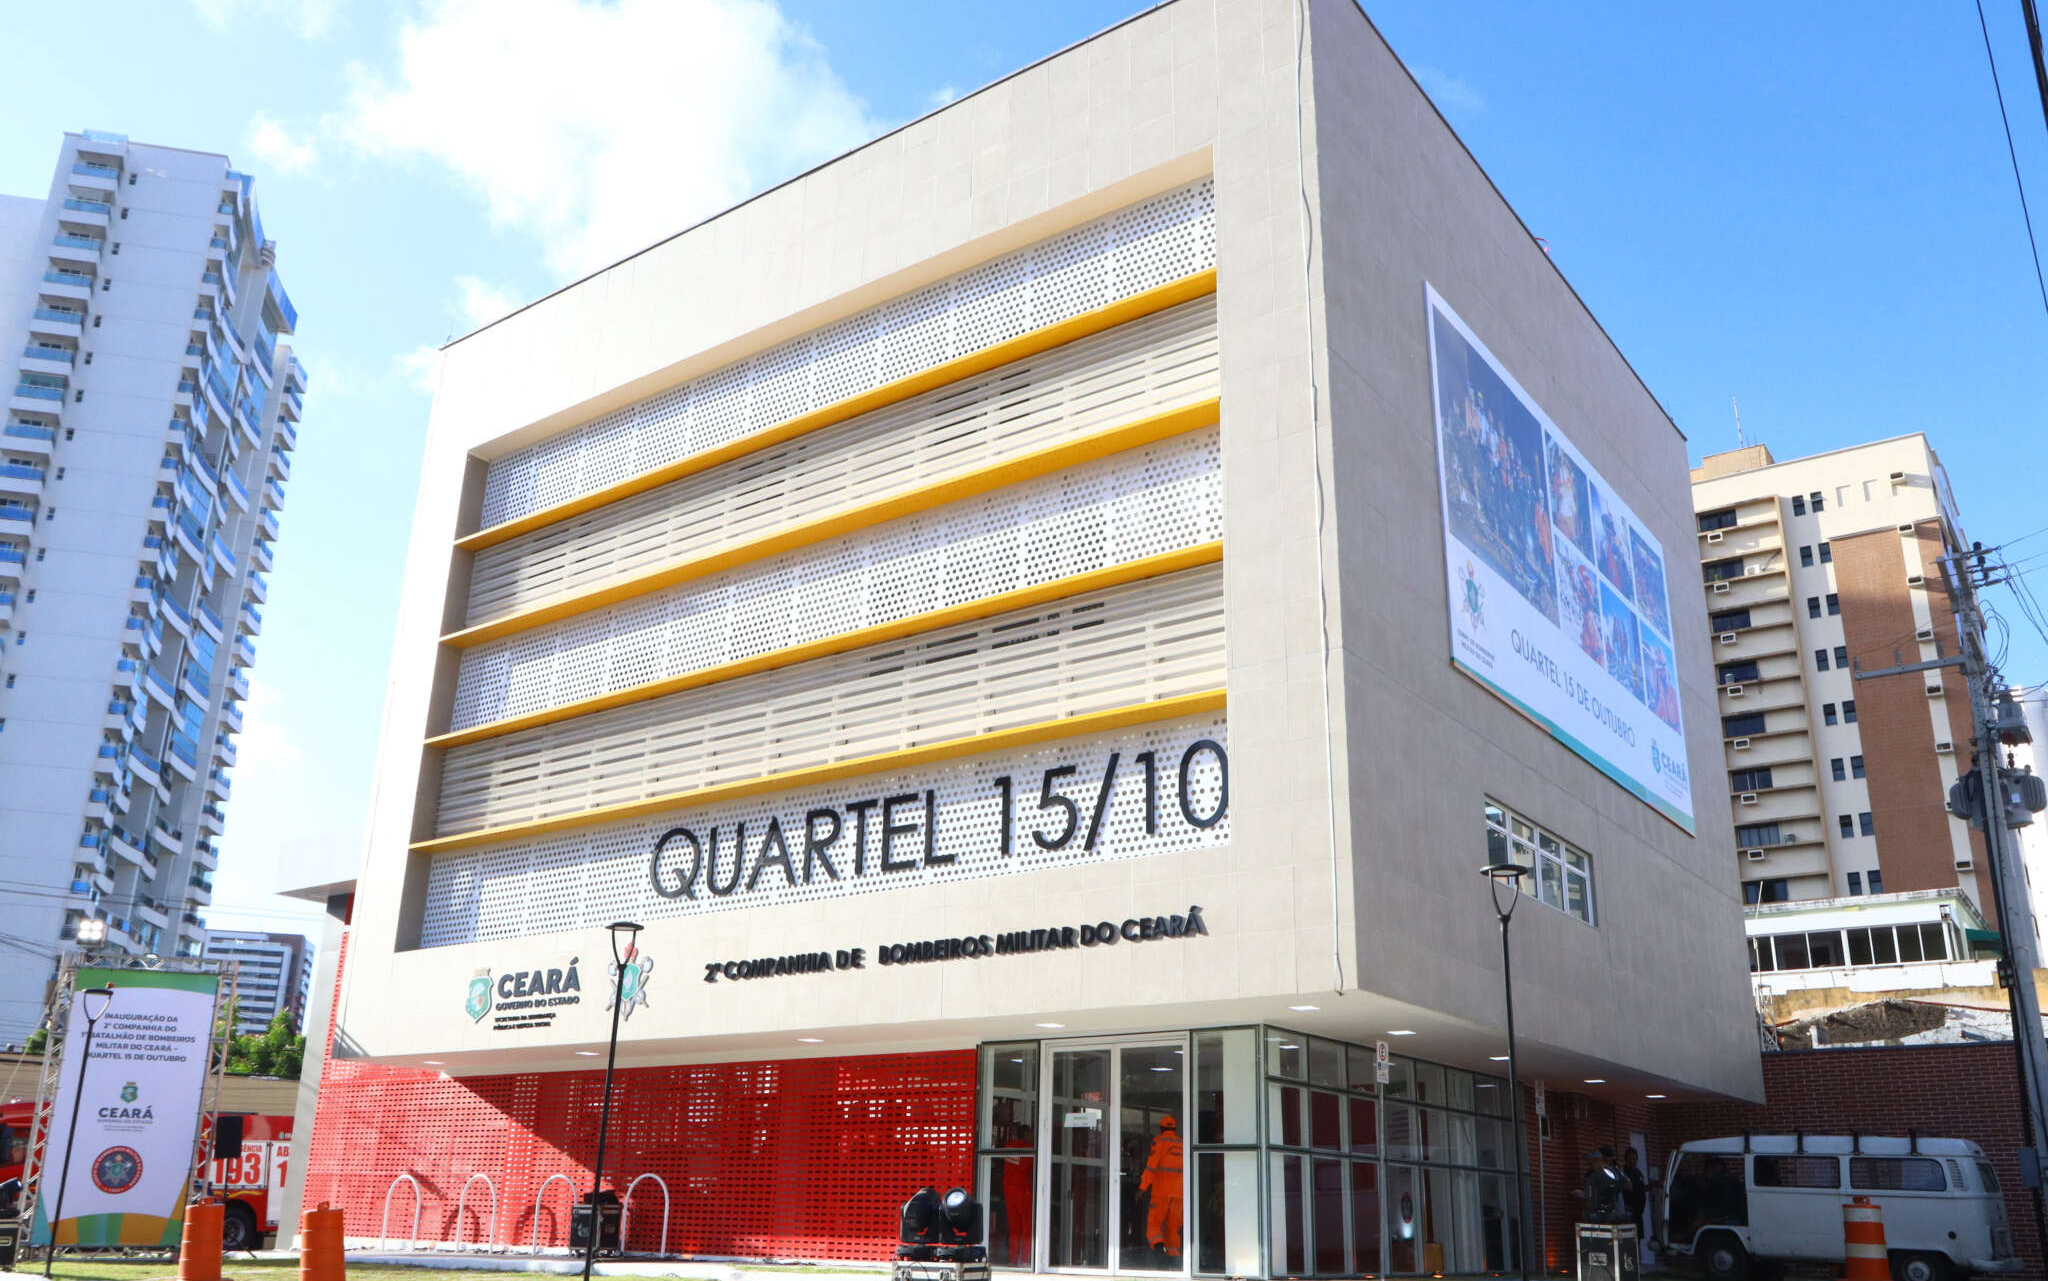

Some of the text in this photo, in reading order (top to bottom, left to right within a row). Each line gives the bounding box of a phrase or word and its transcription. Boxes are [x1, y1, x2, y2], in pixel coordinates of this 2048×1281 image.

[1511, 629, 1561, 688] QUARTEL
[1563, 671, 1575, 698] 15
[1576, 682, 1591, 712] DE
[1592, 696, 1636, 748] OUTUBRO
[650, 739, 1230, 900] QUARTEL 15/10
[724, 952, 835, 981] COMPANHIA
[836, 948, 866, 970] DE
[879, 934, 995, 966] BOMBEIROS
[996, 926, 1079, 954] MILITAR
[1080, 921, 1120, 947] DO
[1120, 905, 1209, 943] CEARÁ
[497, 956, 580, 999] CEARÁ
[495, 996, 580, 1011] GOVERNO DO ESTADO
[104, 1013, 165, 1022] INAUGURAÇÃO
[113, 1023, 162, 1031] COMPANHIA
[148, 1035, 196, 1043] BOMBEIROS
[96, 1042, 128, 1050] MILITAR
[130, 1043, 142, 1051] DO
[144, 1043, 172, 1051] CEARÁ
[133, 1053, 144, 1061] DE
[146, 1054, 187, 1062] OUTUBRO
[98, 1105, 153, 1119] CEARÁ
[212, 1152, 261, 1185] 193
